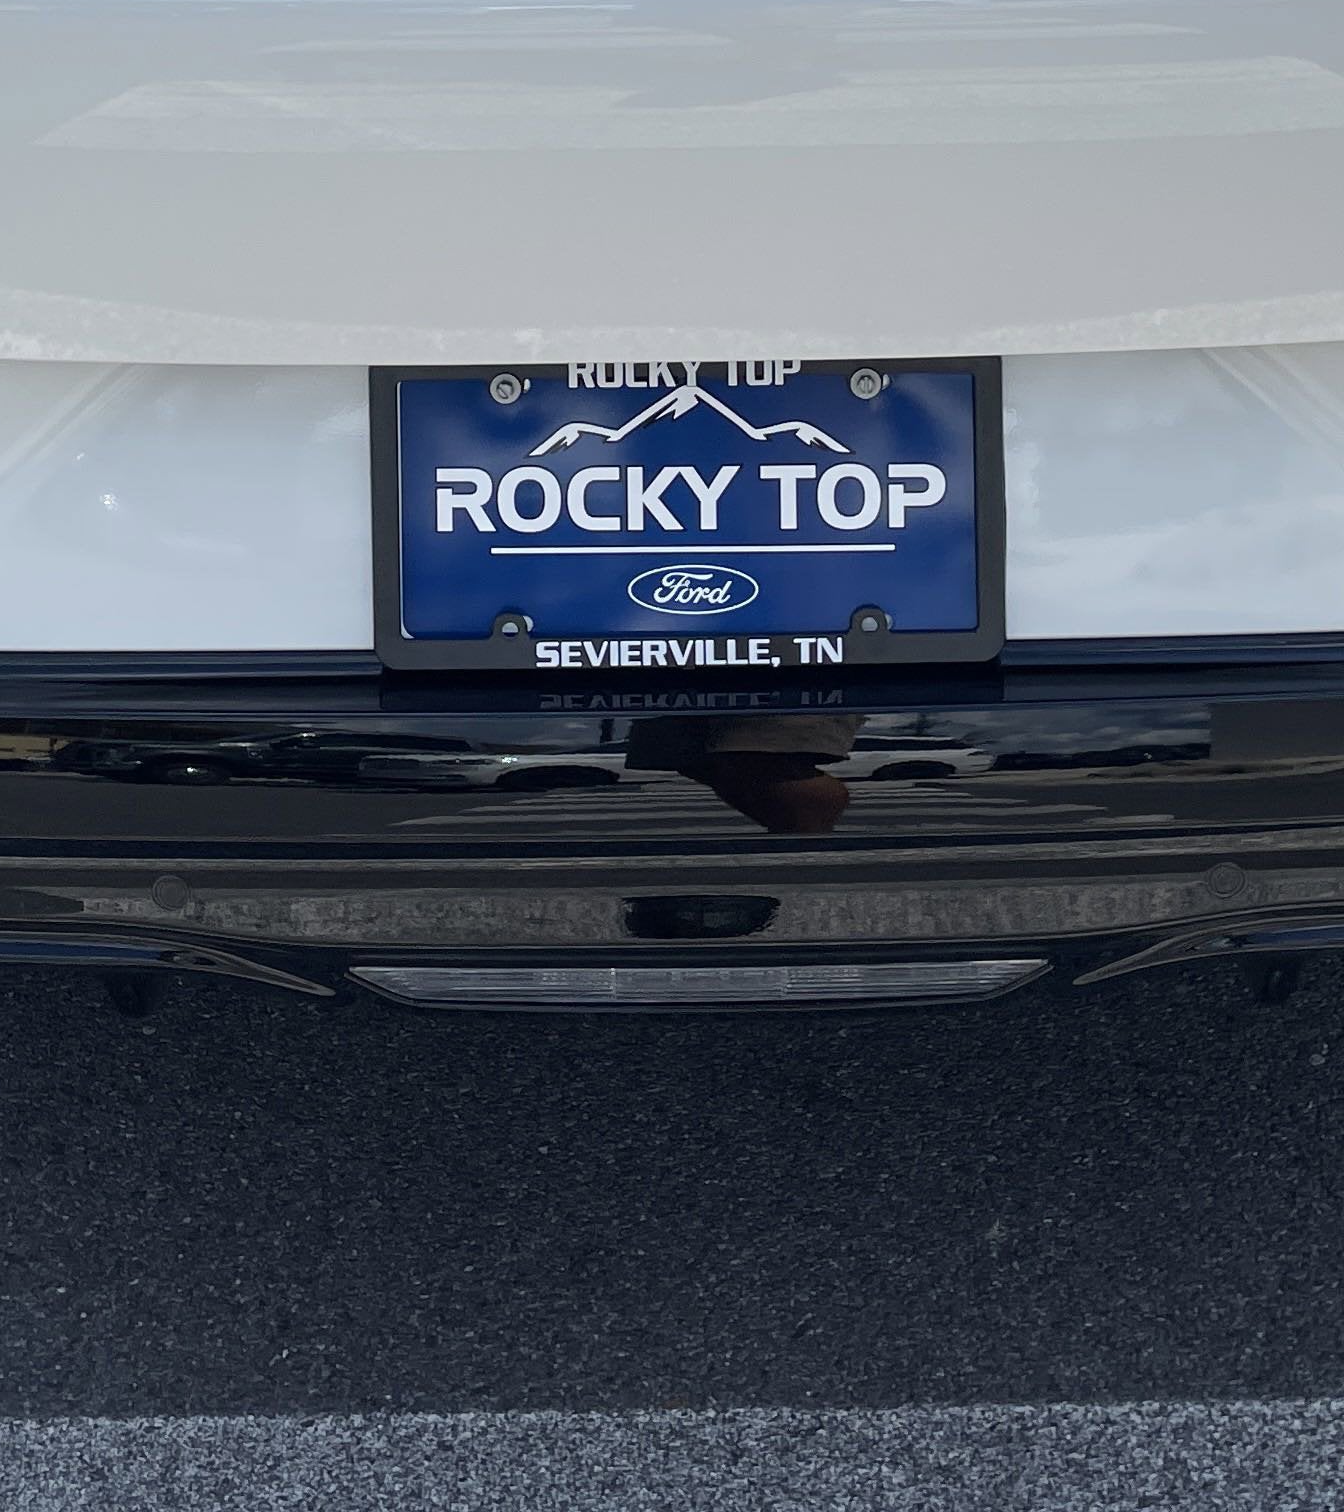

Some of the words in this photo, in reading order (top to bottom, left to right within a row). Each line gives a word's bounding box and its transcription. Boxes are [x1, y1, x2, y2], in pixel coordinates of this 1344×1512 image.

[435, 465, 741, 533] ROCKY
[760, 463, 947, 531] TOP
[653, 571, 733, 604] Ford
[535, 637, 782, 668] SEVIERVILLE,
[793, 636, 844, 665] TN
